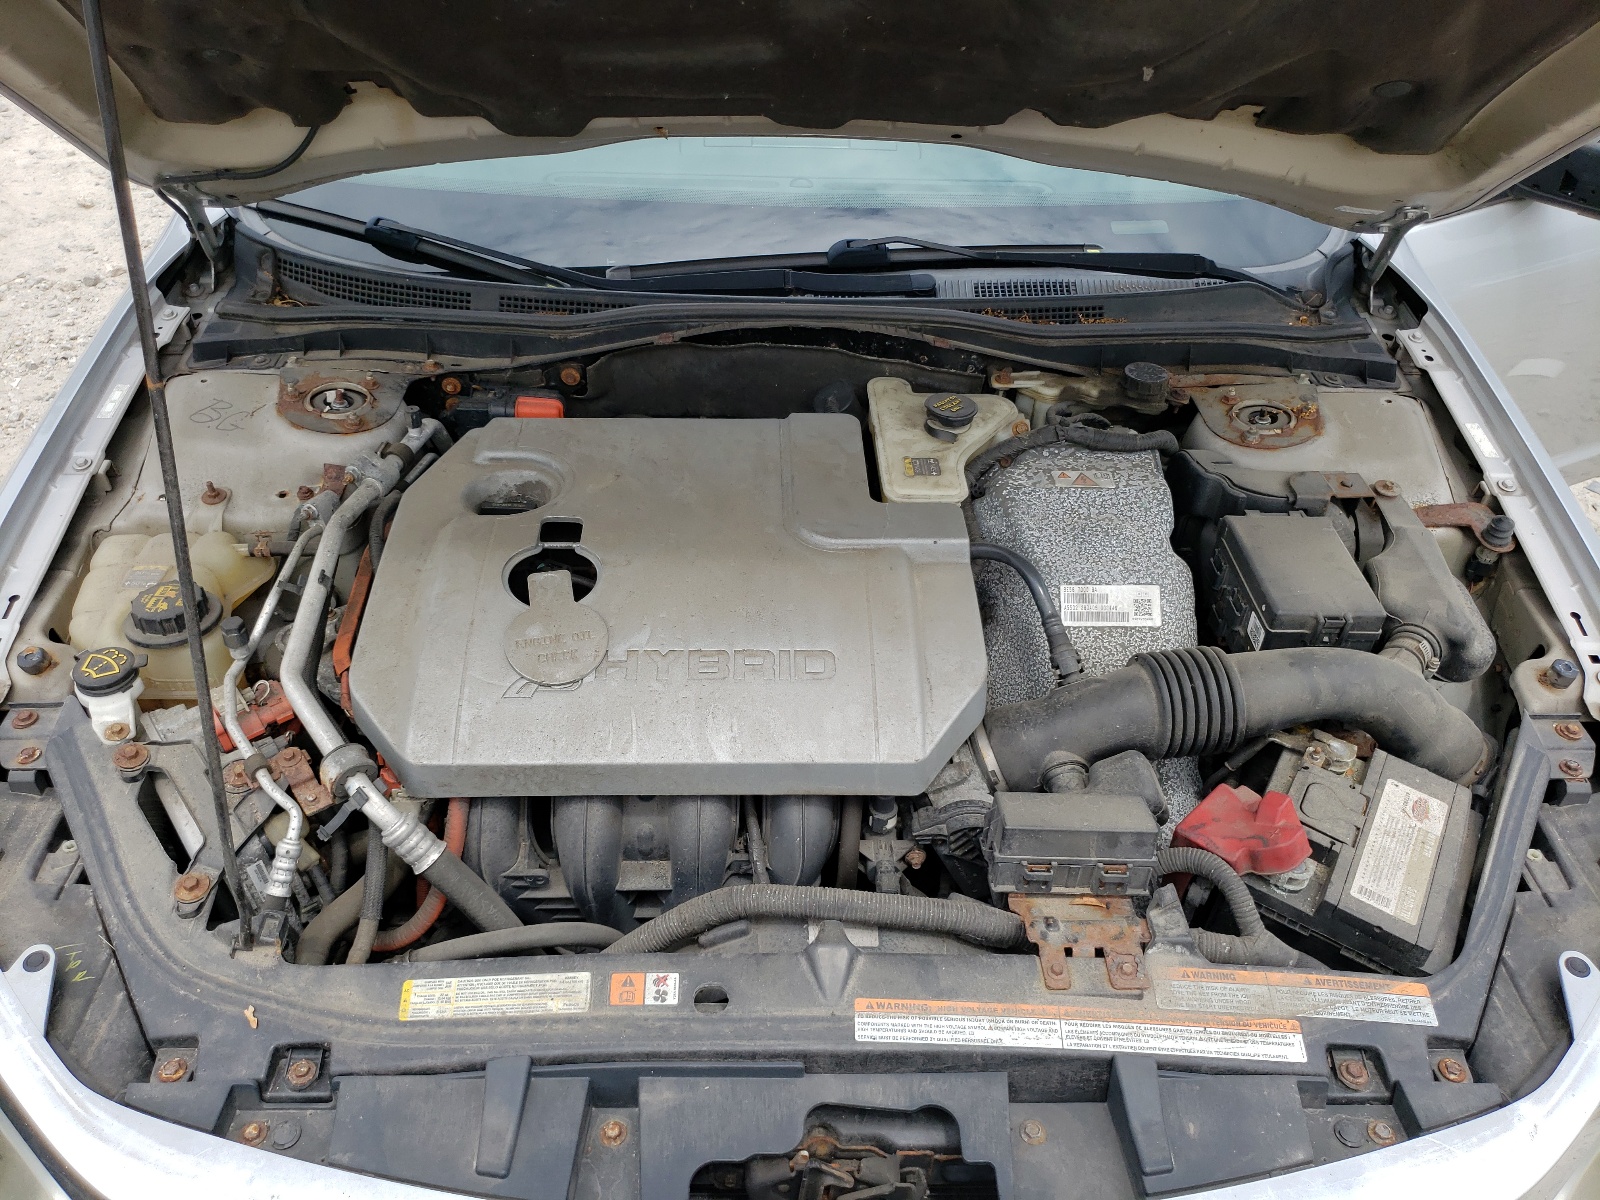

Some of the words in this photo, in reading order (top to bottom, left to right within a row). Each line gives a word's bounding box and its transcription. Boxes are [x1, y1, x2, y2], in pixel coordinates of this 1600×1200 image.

[595, 649, 836, 681] HYBRID
[1191, 971, 1237, 981] WARNING
[1315, 978, 1391, 990] AVERTISSEMENT
